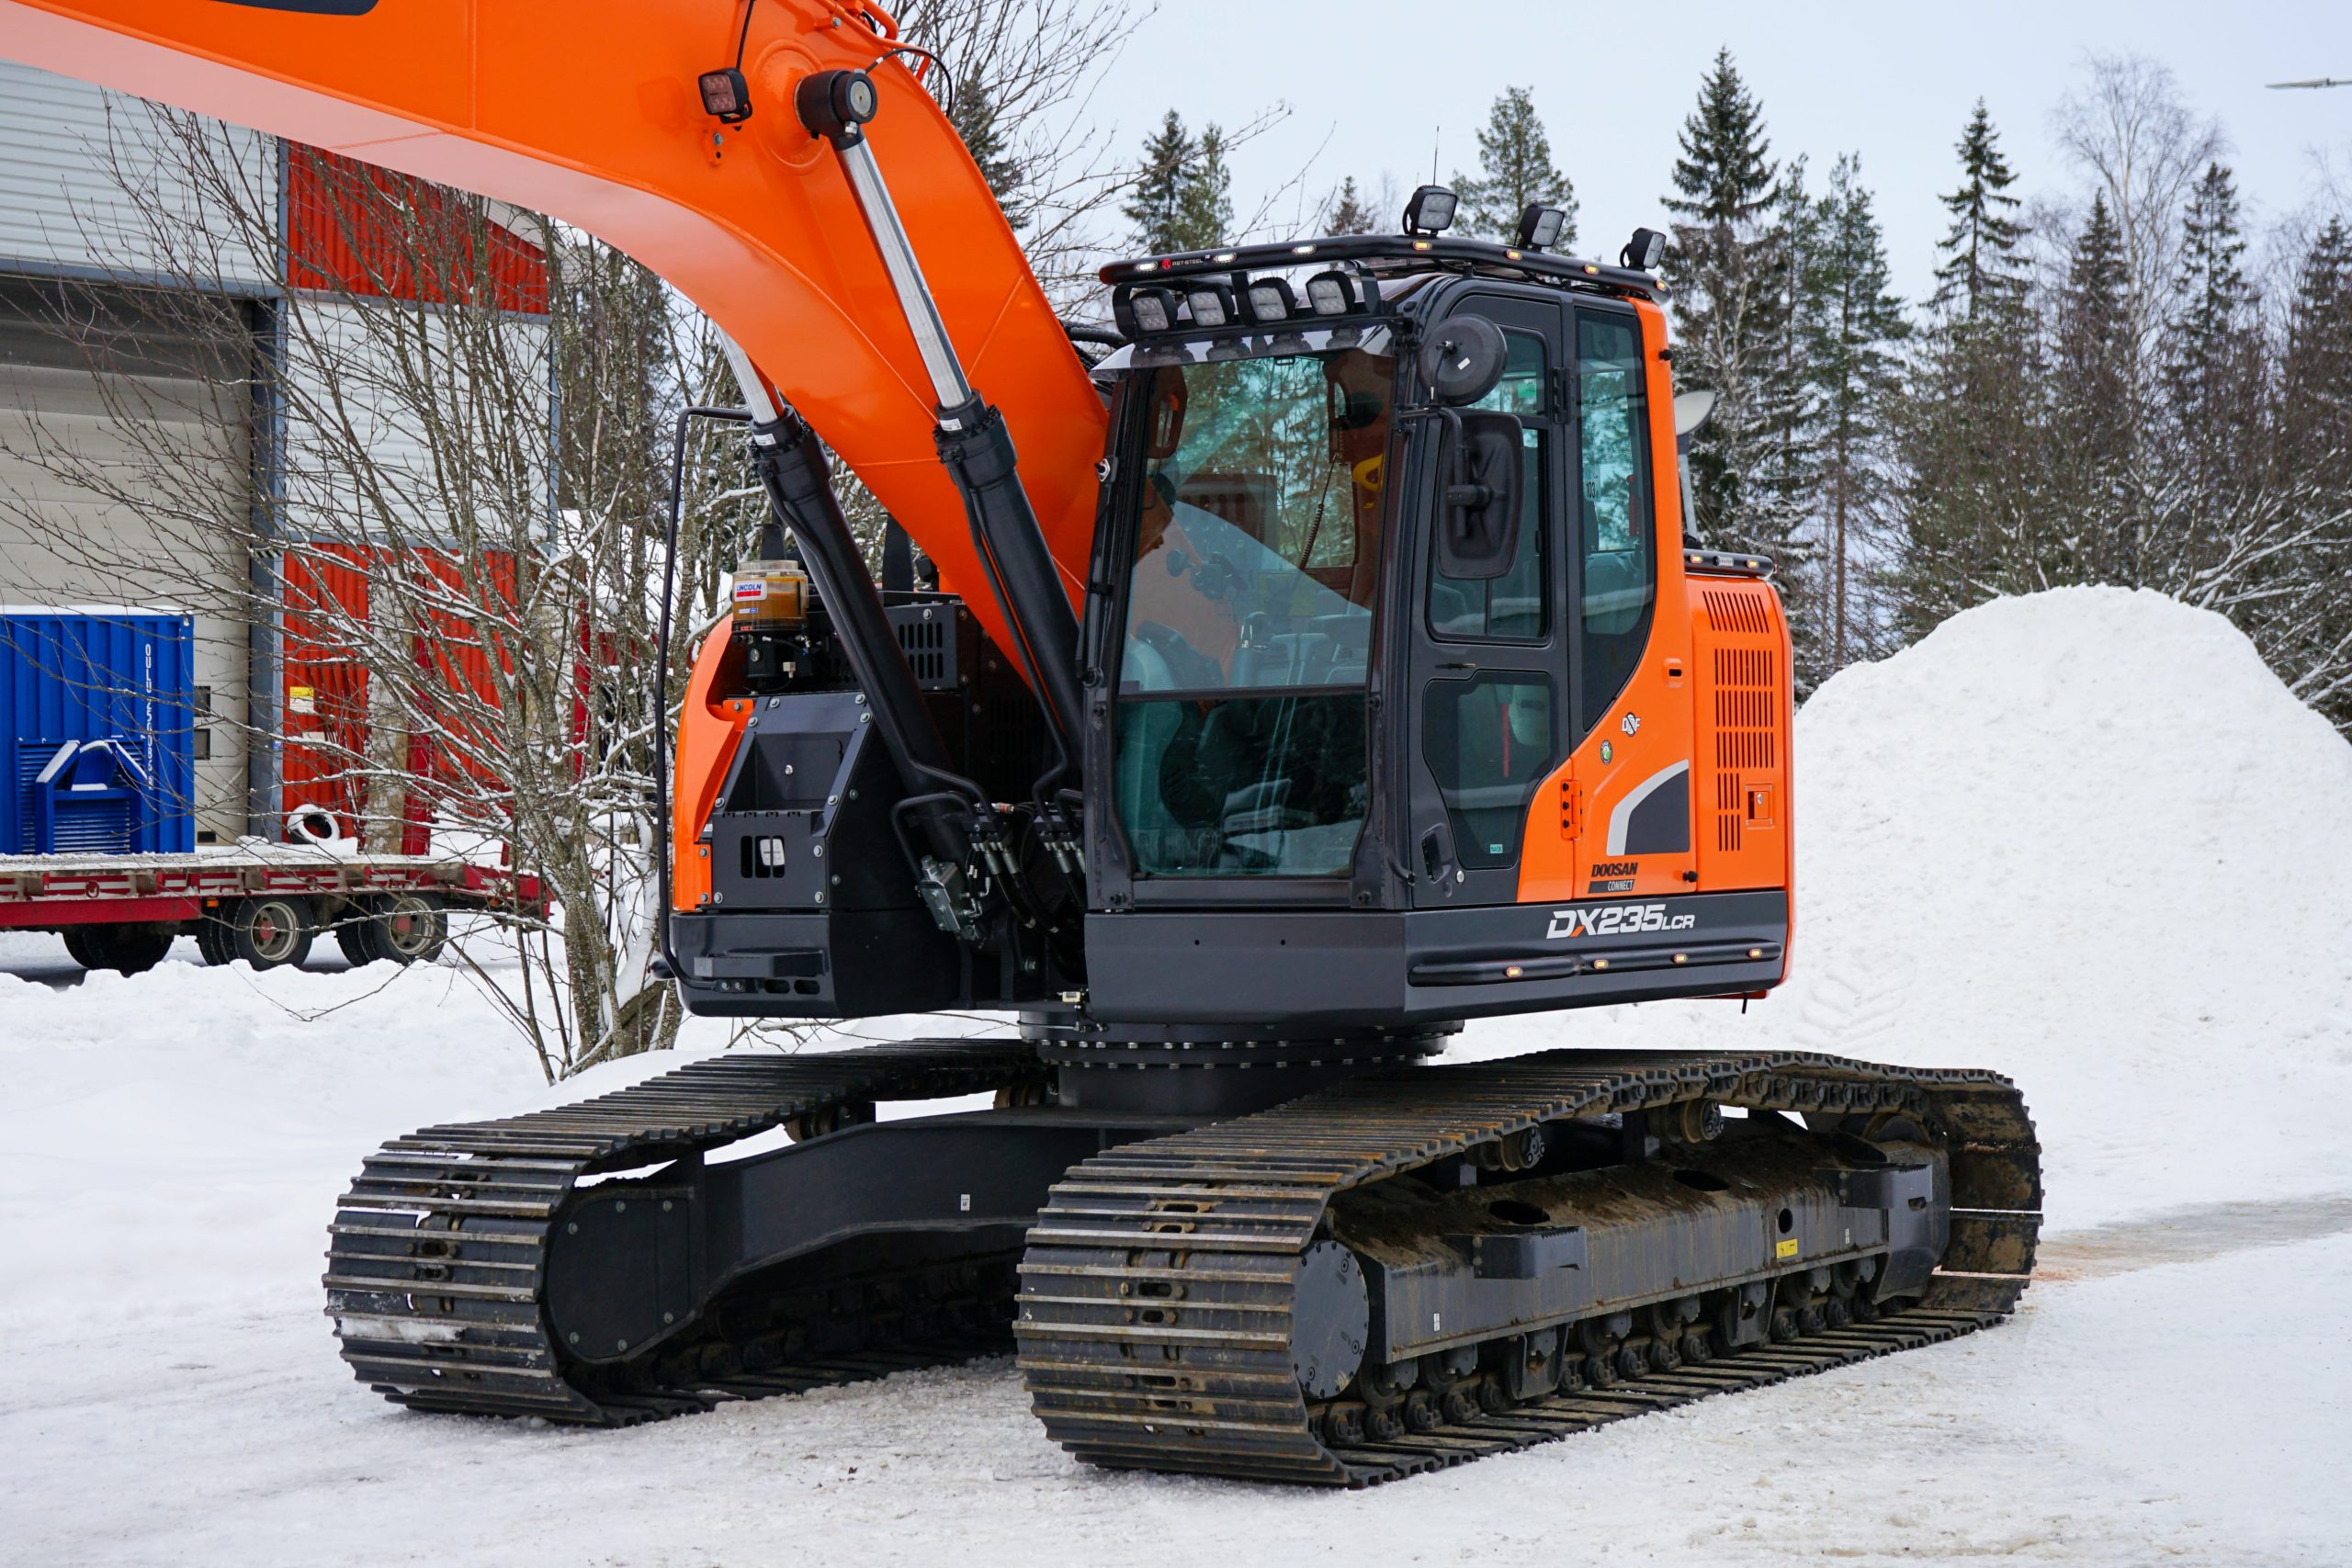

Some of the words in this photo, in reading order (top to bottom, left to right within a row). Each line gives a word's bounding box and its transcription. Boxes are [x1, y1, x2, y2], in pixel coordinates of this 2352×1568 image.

[736, 583, 763, 592] LINCOLN
[1591, 862, 1638, 877] DOOSAN
[1608, 879, 1634, 891] CONNECT
